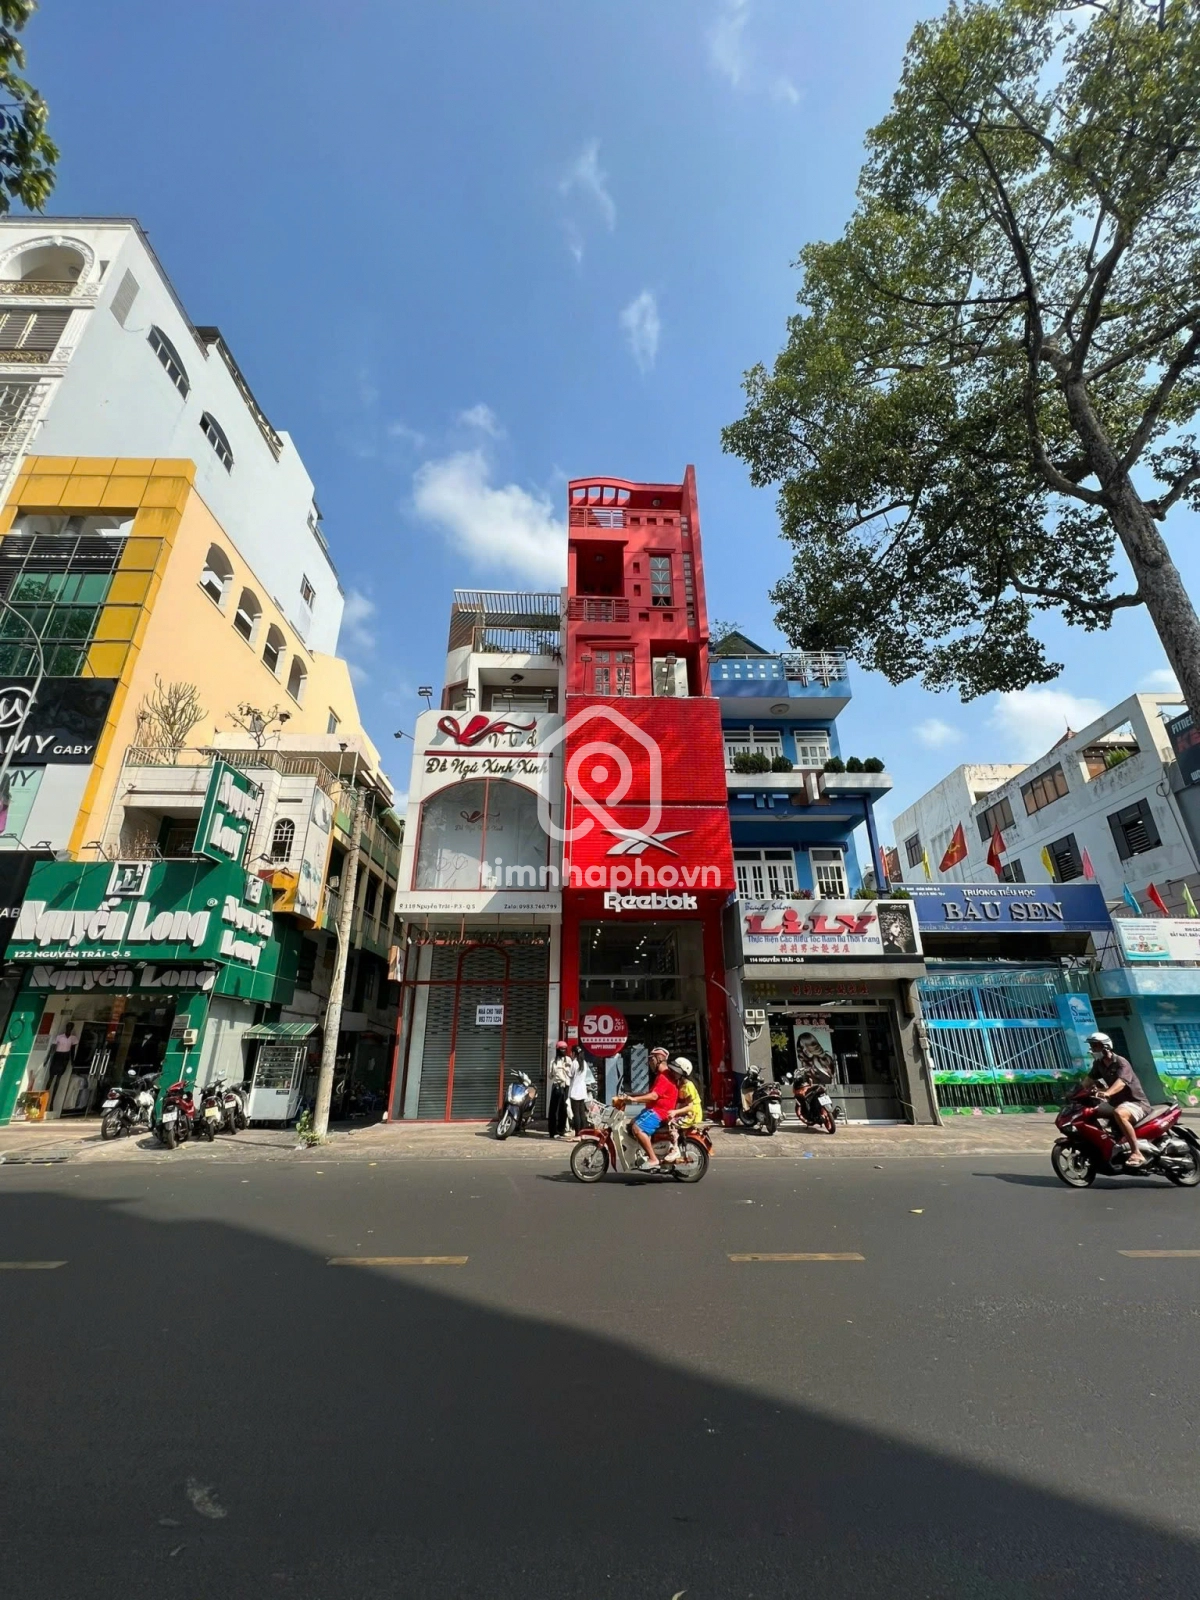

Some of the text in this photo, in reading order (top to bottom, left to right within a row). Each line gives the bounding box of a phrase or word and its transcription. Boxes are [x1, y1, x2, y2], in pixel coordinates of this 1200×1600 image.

[0, 735, 93, 754] MY GABY
[481, 758, 514, 774] Xinh
[604, 891, 698, 912] Reebok
[1018, 889, 1036, 898] HỌC
[1010, 902, 1064, 921] SEN
[127, 901, 211, 947] Long
[34, 948, 79, 958] NGUYỄN
[758, 955, 780, 963] NGUYỄN
[139, 965, 216, 991] Long
[583, 1015, 614, 1035] 50
